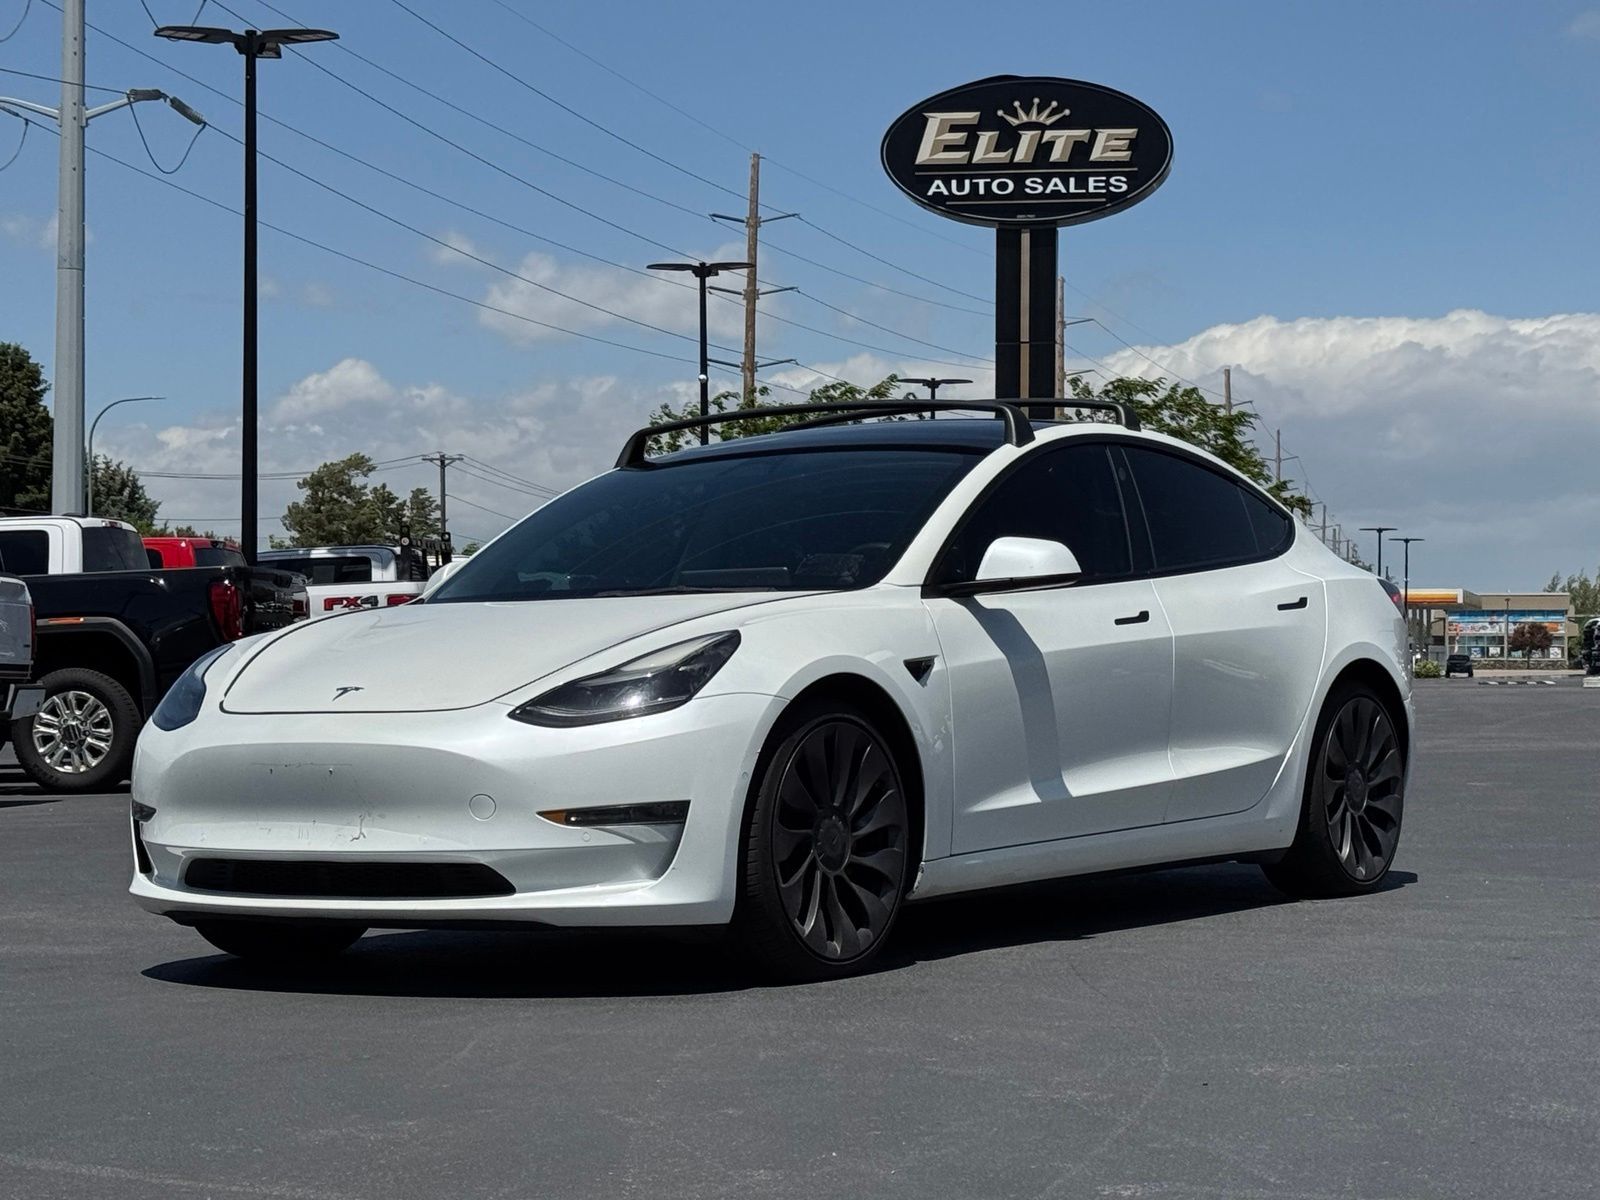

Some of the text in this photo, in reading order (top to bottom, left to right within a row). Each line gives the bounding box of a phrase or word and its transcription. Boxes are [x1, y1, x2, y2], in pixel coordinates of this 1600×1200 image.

[914, 111, 1139, 165] ELITE
[927, 176, 1128, 196] AUTO SALES
[324, 595, 379, 611] FX4
